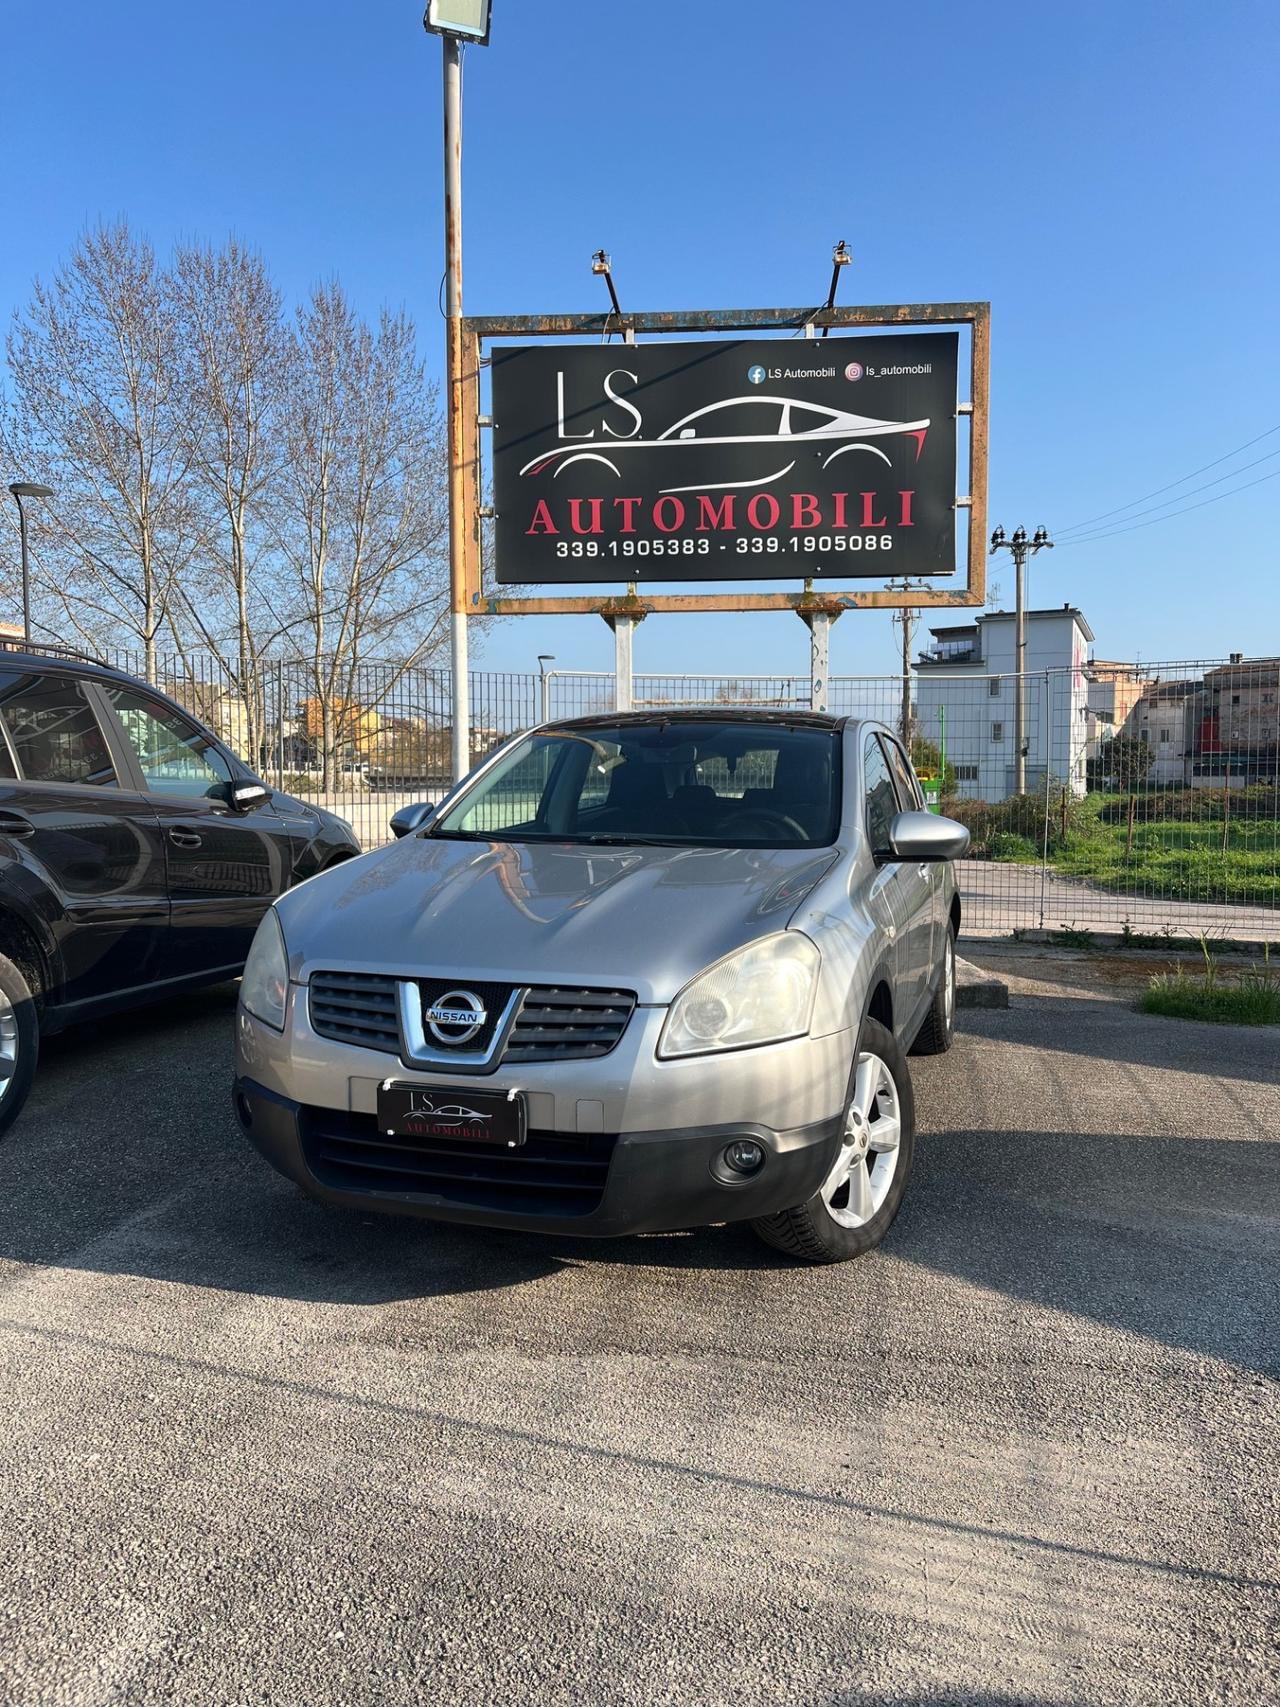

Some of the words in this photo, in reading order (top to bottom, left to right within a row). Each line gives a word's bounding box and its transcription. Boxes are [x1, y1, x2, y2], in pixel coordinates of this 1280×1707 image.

[768, 368, 782, 379] LS
[784, 367, 836, 378] Automobili
[865, 363, 932, 379] ls_automobili
[556, 369, 642, 438] LS
[524, 490, 915, 535] AUTOMOBILI
[556, 539, 710, 557] 339.1905383
[736, 534, 893, 553] 339.1905086
[430, 1011, 477, 1022] NISSAN
[406, 1122, 492, 1139] AUTOMOBILI
